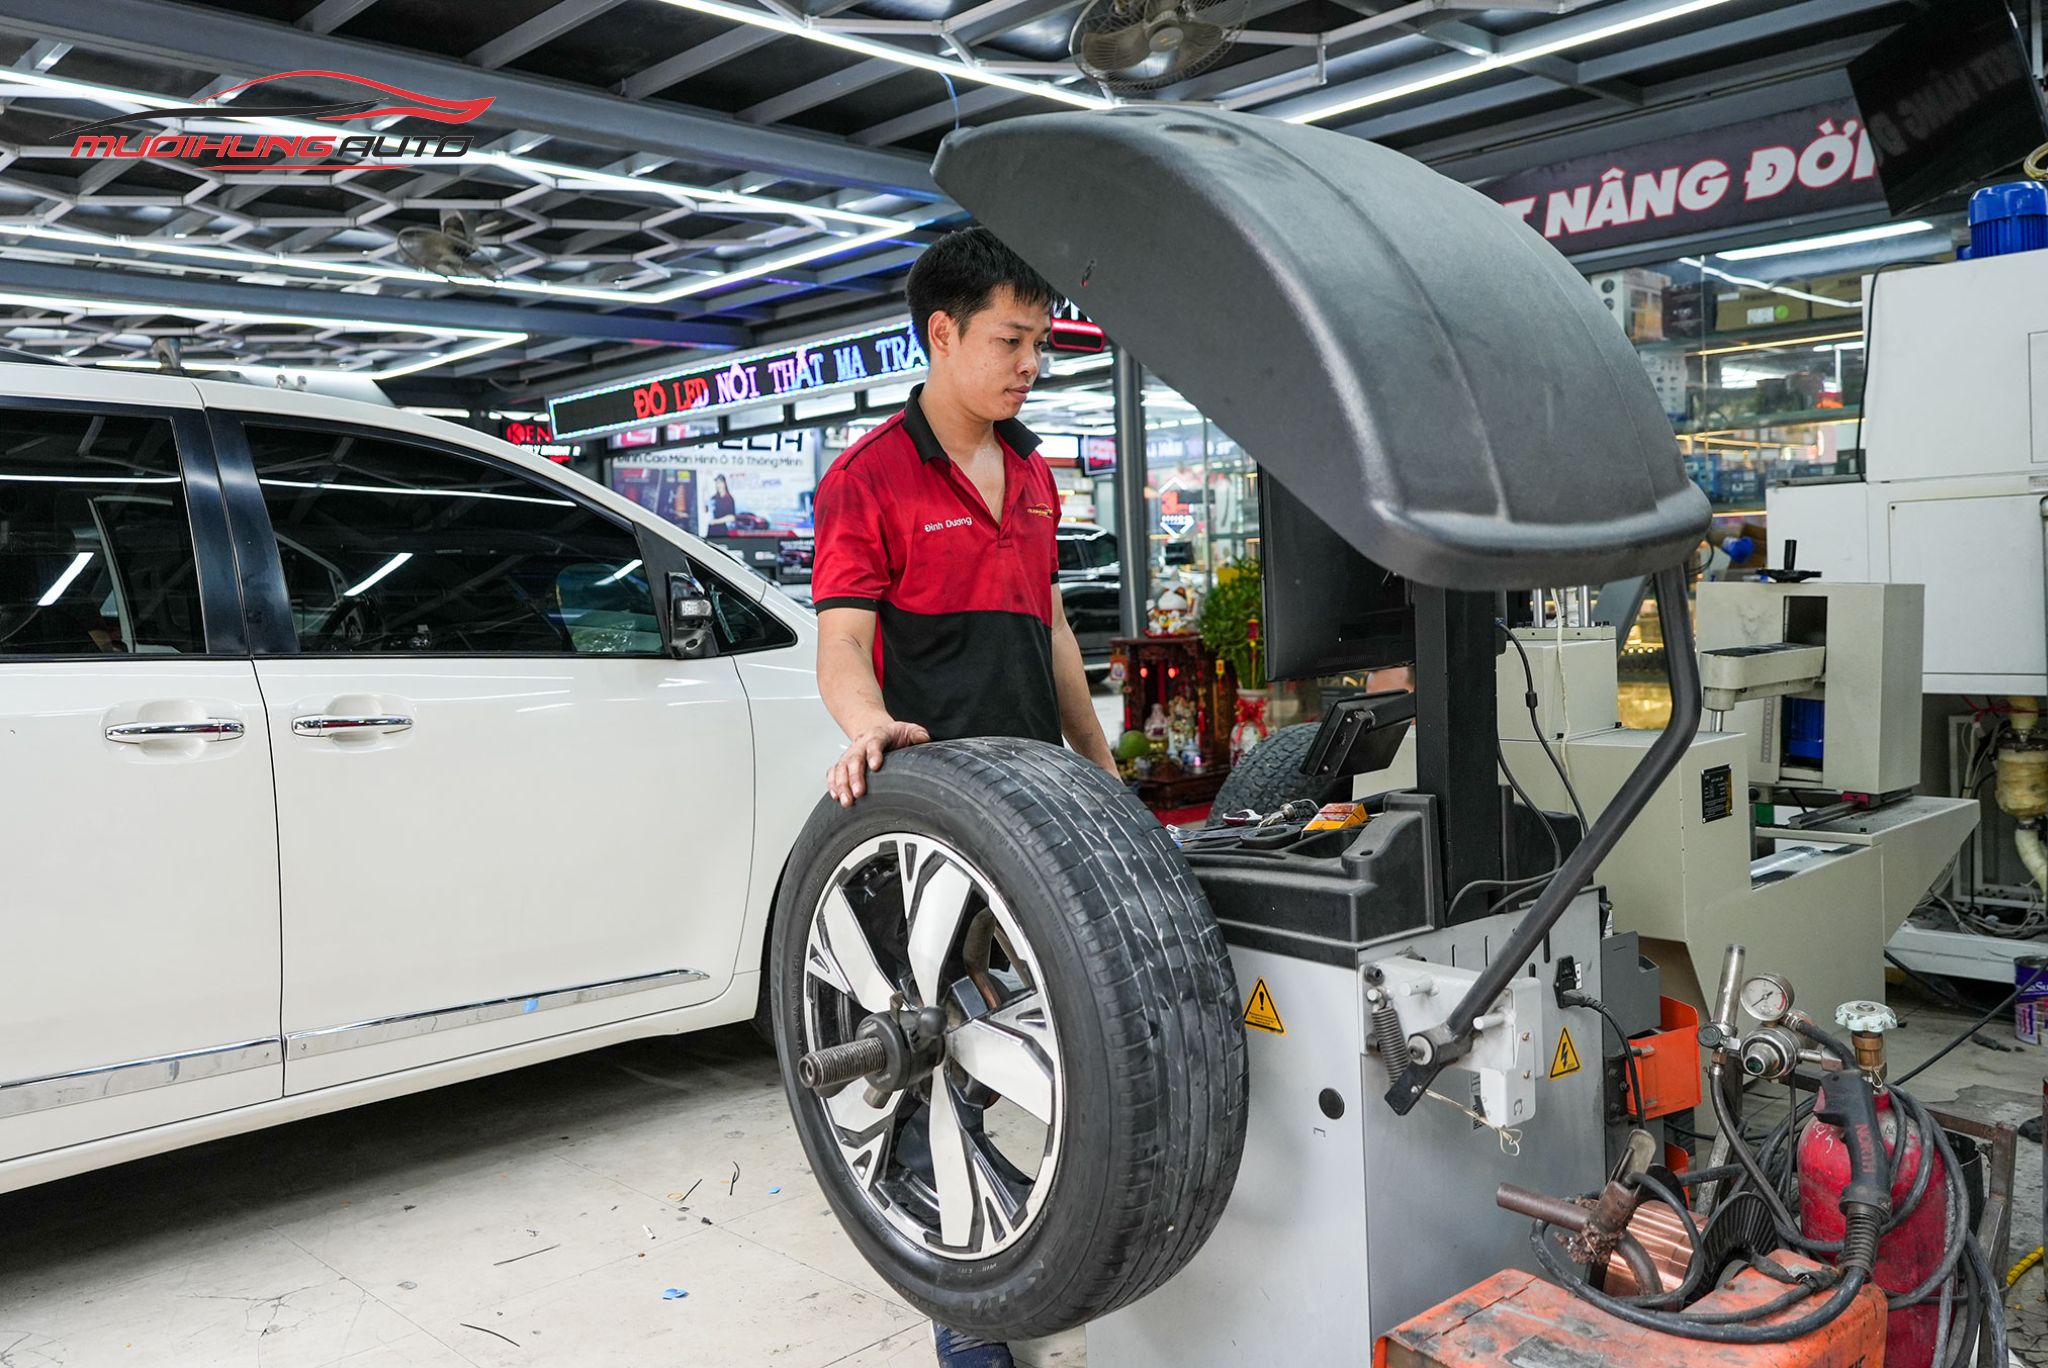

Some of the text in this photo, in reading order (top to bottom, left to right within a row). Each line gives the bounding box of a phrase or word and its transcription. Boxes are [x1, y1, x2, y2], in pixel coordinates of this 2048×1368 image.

[1544, 160, 1730, 239] NÂNG
[673, 378, 710, 412] LED
[834, 345, 868, 381] MA
